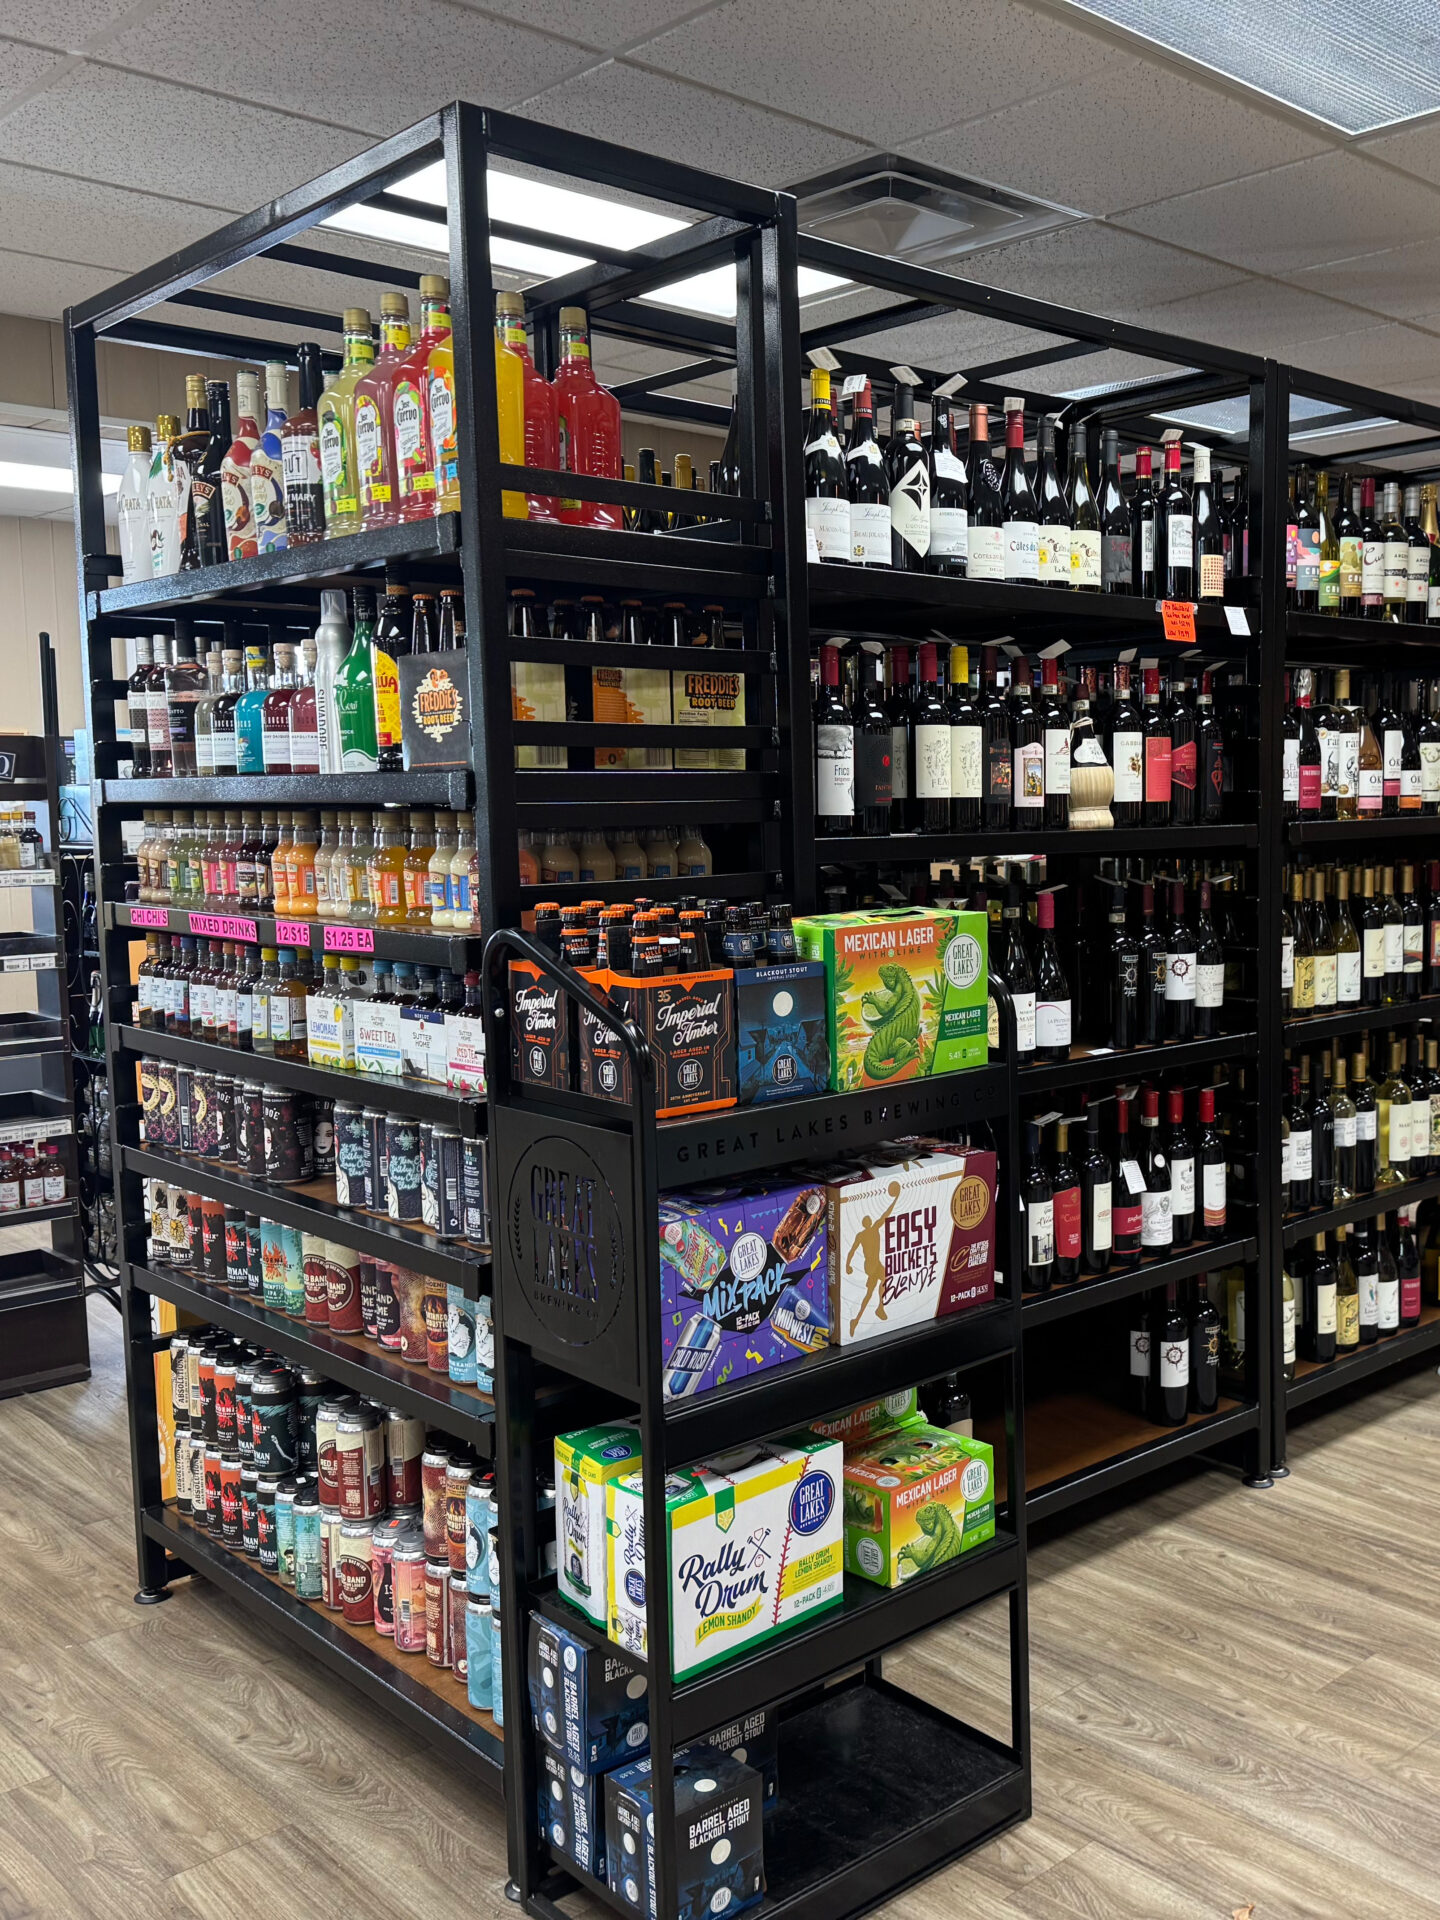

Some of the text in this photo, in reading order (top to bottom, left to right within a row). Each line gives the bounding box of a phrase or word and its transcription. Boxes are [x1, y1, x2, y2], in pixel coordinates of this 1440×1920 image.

[396, 408, 418, 425] Cuervo
[291, 493, 316, 501] MARY
[692, 698, 736, 708] ROOT BEER
[423, 715, 454, 726] ROOT BEER
[132, 910, 168, 924] CHI CHI'S
[190, 916, 256, 938] MIXED DRINKS
[356, 933, 372, 948] EA
[844, 926, 934, 952] MEXICAN LAGER
[858, 946, 922, 960] WITH LIME
[952, 942, 973, 960] GREAT
[756, 966, 808, 978] BLACKOUT STOUT
[953, 958, 974, 976] LAKES
[516, 989, 558, 1016] Imperial
[658, 990, 672, 1002] 35
[526, 1007, 556, 1030] Amber
[656, 993, 722, 1031] Imperial
[945, 1010, 980, 1022] MEXICAN LAGER
[311, 1021, 338, 1036] LEMONADE
[360, 1028, 396, 1044] SWEET TEA
[412, 1032, 432, 1042] SUTTER
[672, 1020, 718, 1046] Amber
[416, 1040, 430, 1048] HOME
[456, 1048, 469, 1058] ICED
[670, 1048, 687, 1056] LAGER
[688, 1046, 702, 1054] AGED
[683, 1063, 698, 1074] GREAT
[778, 1058, 792, 1070] GREAT
[684, 1072, 698, 1084] LAKES
[776, 1068, 792, 1080] LAKES
[682, 1090, 710, 1099] ANNIVERSARY
[676, 1132, 759, 1162] GREAT
[776, 1114, 849, 1143] LAKES
[864, 1094, 961, 1124] BREWING
[530, 1164, 597, 1238] GREAT
[960, 1184, 980, 1202] GREAT
[960, 1200, 980, 1218] LAKES
[885, 1206, 937, 1254] EASY
[738, 1239, 757, 1256] GREAT
[532, 1222, 599, 1302] LAKES
[739, 1256, 760, 1272] LAKES
[884, 1243, 938, 1277] BUCKETS
[328, 1283, 346, 1291] BAND
[950, 1290, 970, 1303] 12-PACK
[774, 1308, 815, 1344] MIDWEST
[891, 1396, 906, 1410] LAKES
[814, 1406, 880, 1436] MEXICAN LAGER
[966, 1465, 982, 1480] GREAT
[800, 1478, 825, 1504] GREAT
[896, 1468, 958, 1508] MEXICAN LAGER
[967, 1478, 983, 1492] LAKES
[562, 1497, 581, 1524] Rally
[800, 1498, 825, 1523] LAKES
[566, 1518, 587, 1548] Drum
[624, 1526, 636, 1566] Rally
[678, 1540, 747, 1592] Rally
[794, 1554, 832, 1578] LEMON SHANDY
[798, 1547, 830, 1568] RALLY DRUM
[348, 1576, 367, 1585] BAND
[628, 1576, 636, 1603] GREAT
[695, 1571, 769, 1618] Drum
[794, 1592, 816, 1608] 12-PACK
[698, 1605, 757, 1640] LEMON SHANDY
[625, 1620, 636, 1650] Rally
[632, 1620, 642, 1651] Drum
[564, 1676, 572, 1718] BLACKOUT
[570, 1682, 580, 1752] BARREL AGED
[709, 1712, 765, 1746] BARREL AGED
[744, 1724, 765, 1741] STOUT
[572, 1792, 581, 1832] BLACKOUT
[689, 1798, 750, 1838] BARREL AGED
[578, 1794, 589, 1867] BARREL AGED
[690, 1813, 750, 1850] BLACKOUT STOUT
[647, 1844, 657, 1917] BLACKOUT STOUT
